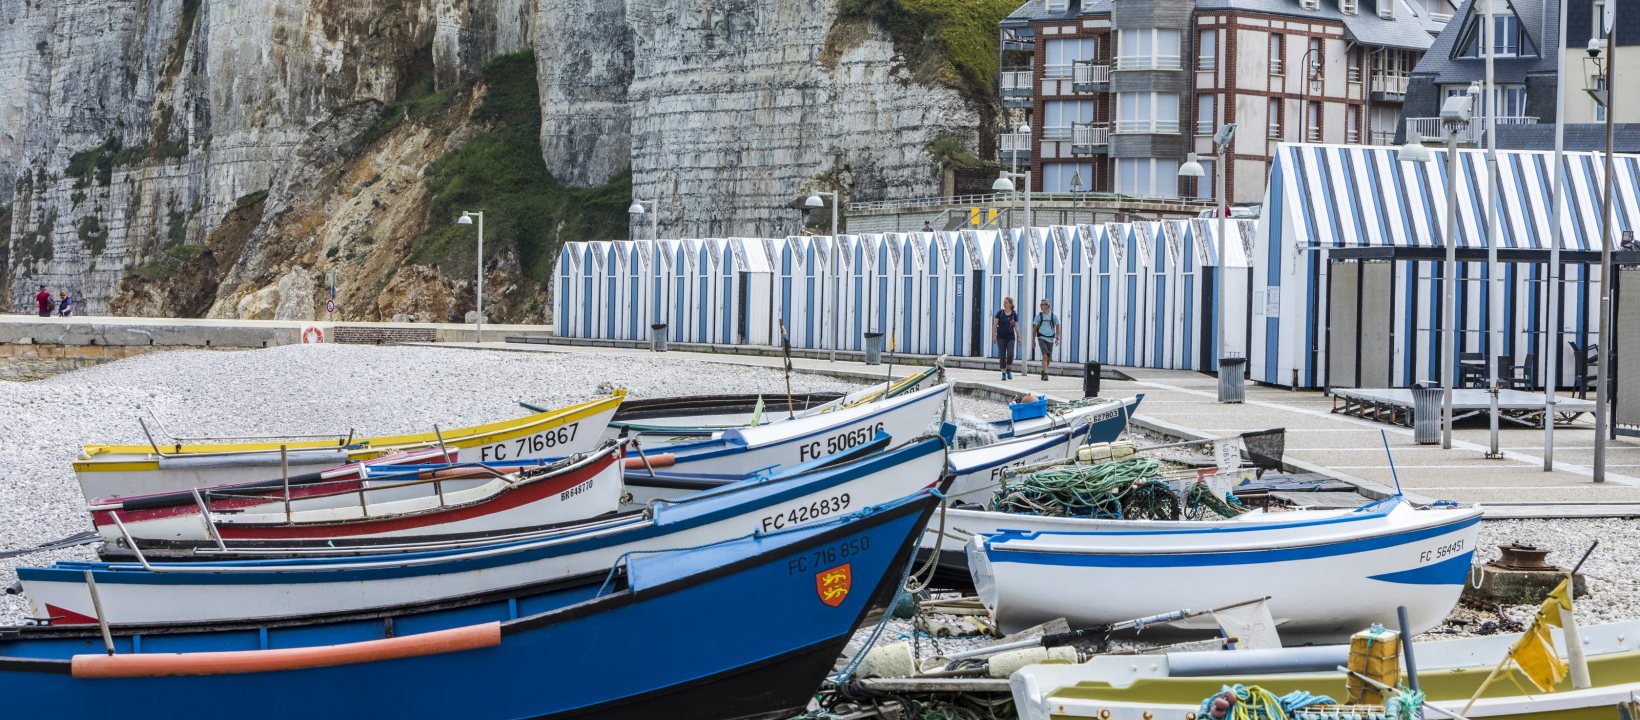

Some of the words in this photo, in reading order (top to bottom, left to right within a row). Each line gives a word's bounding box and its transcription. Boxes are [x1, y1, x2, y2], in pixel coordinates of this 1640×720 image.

[481, 444, 506, 462] FC
[516, 422, 579, 457] 716867
[800, 441, 821, 462] FC
[762, 513, 785, 532] FC
[788, 493, 851, 524] 426839
[789, 556, 807, 576] FC
[813, 547, 836, 567] 716
[841, 536, 870, 558] 850
[1420, 550, 1432, 563] FC
[1436, 539, 1465, 559] 564451
